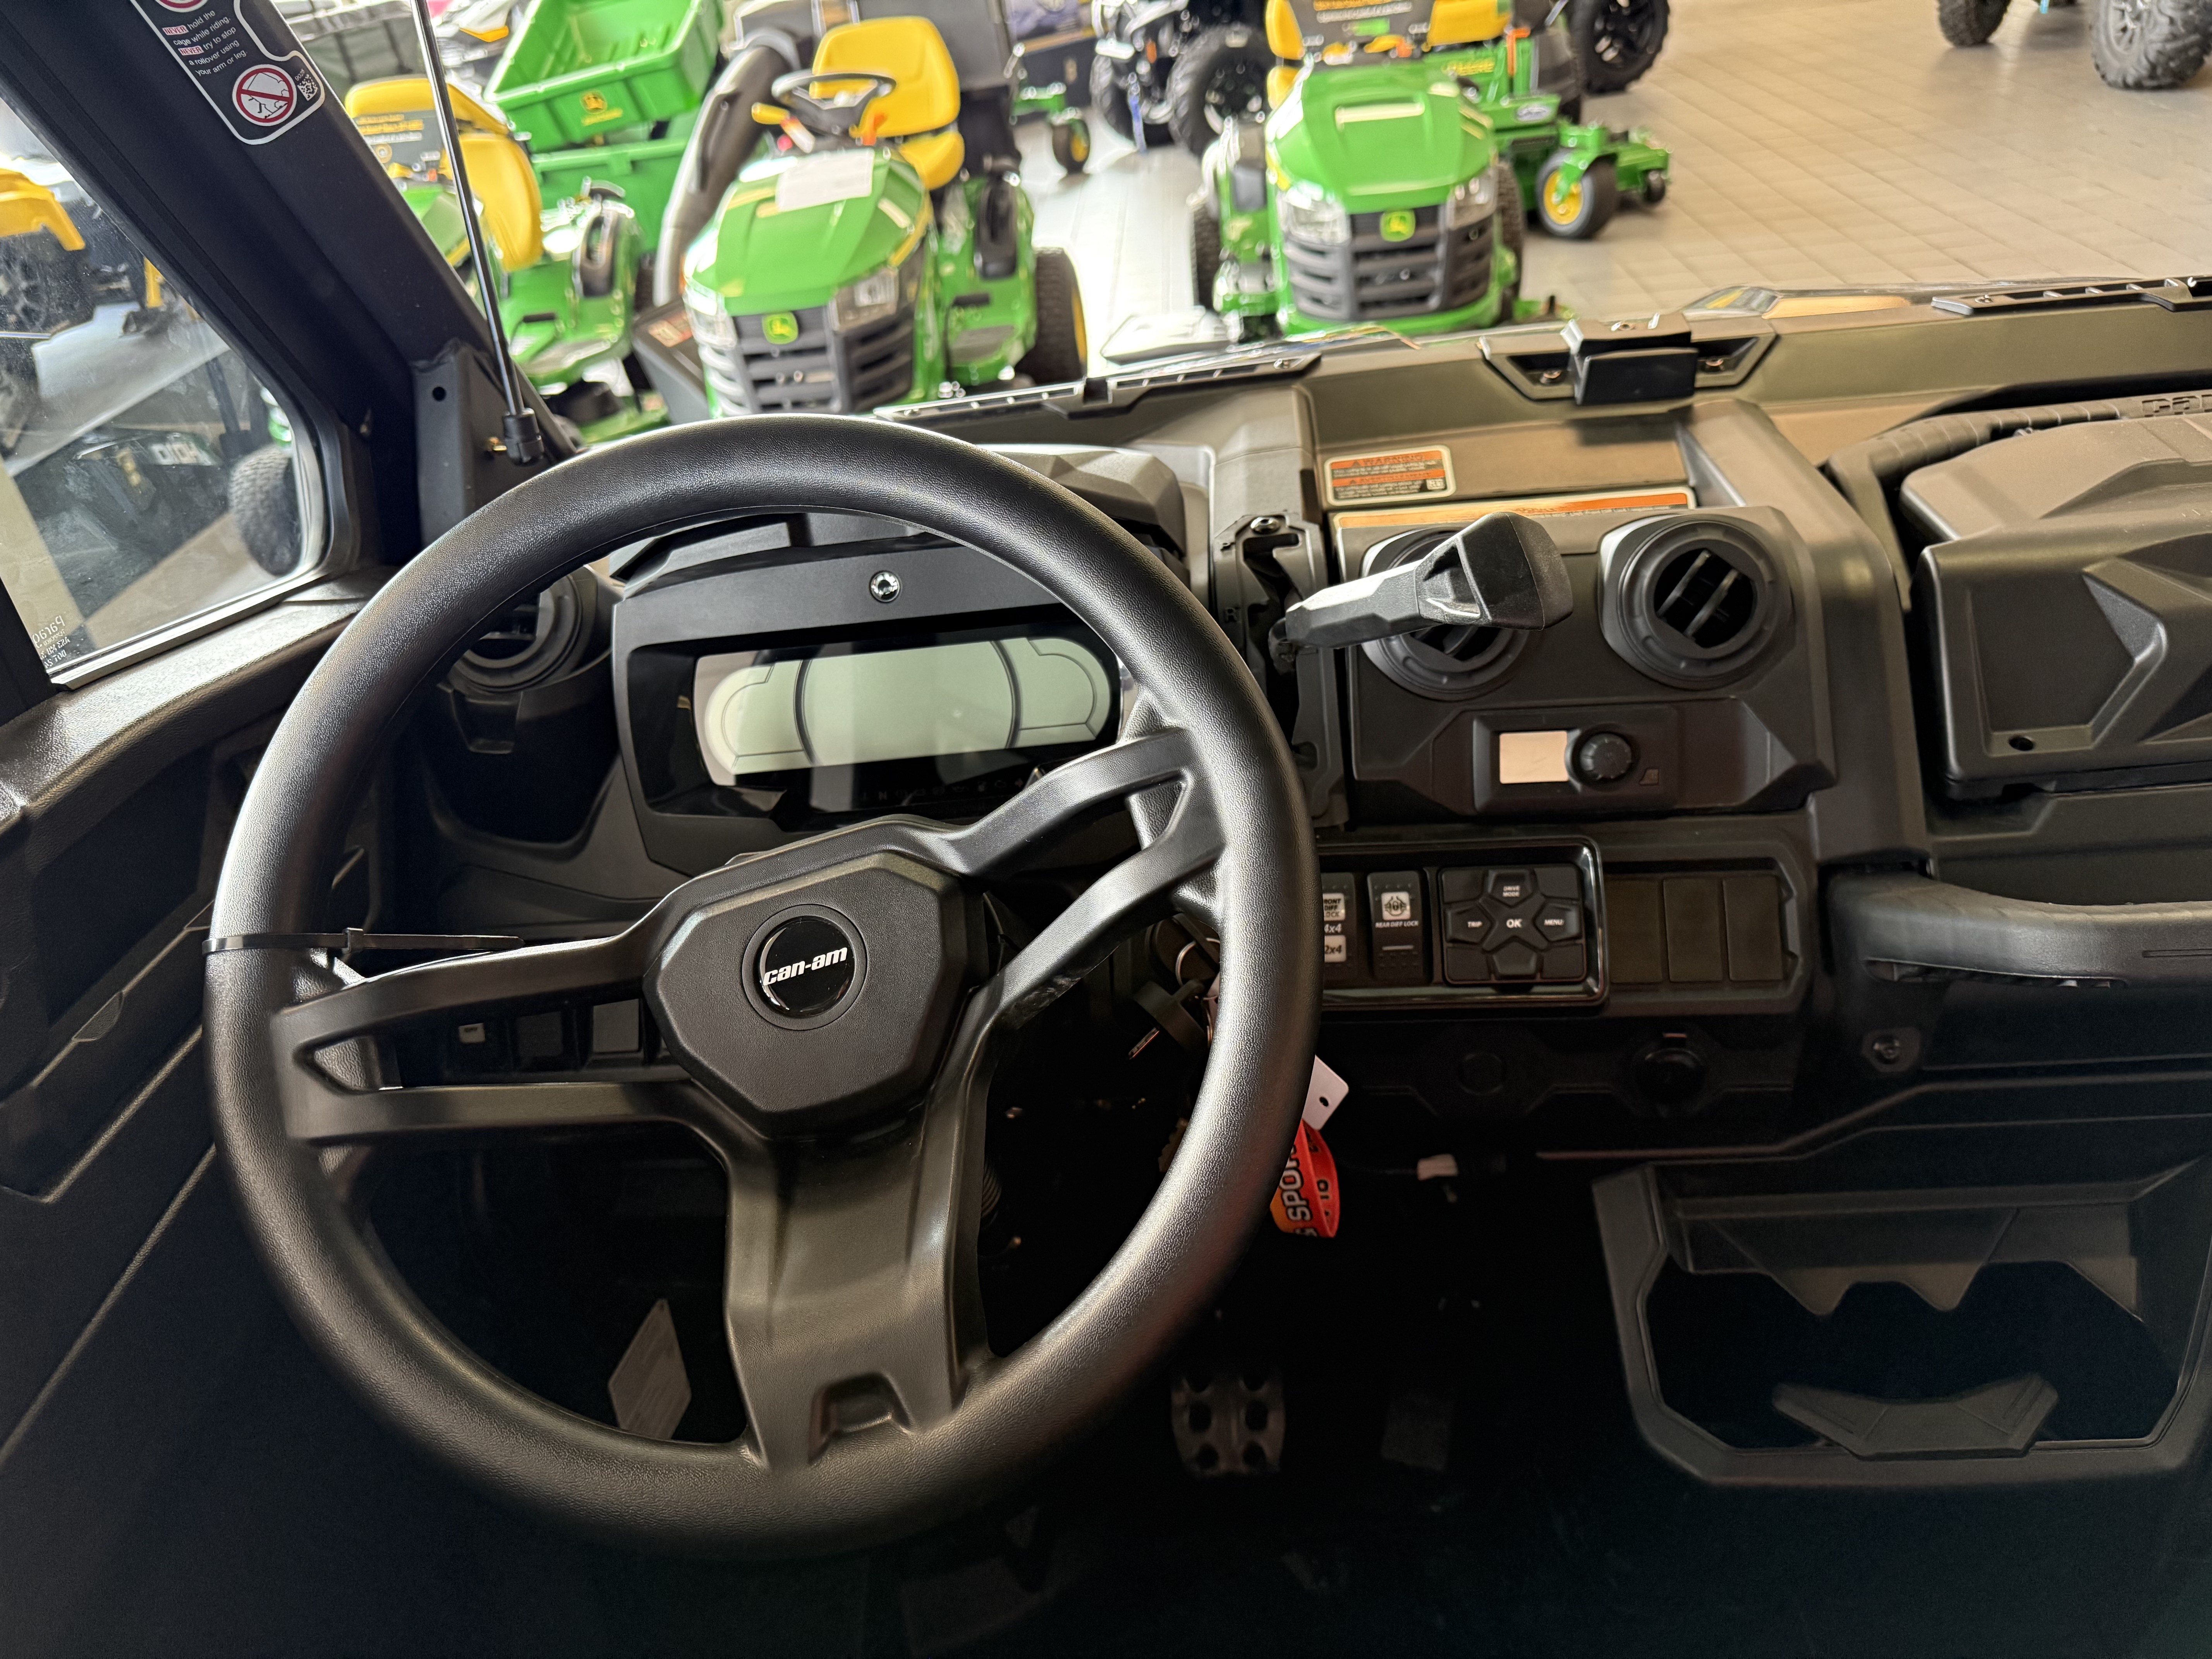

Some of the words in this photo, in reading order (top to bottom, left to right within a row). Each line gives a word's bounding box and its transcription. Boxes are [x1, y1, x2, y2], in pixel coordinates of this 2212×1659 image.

[164, 26, 187, 34] NEVER
[187, 16, 204, 30] hold
[203, 10, 215, 20] the
[191, 29, 210, 42] while
[210, 16, 231, 32] riding.
[180, 46, 202, 55] NEVER
[203, 41, 213, 50] try
[222, 27, 236, 39] stop
[196, 51, 220, 65] rollover
[220, 40, 240, 54] using
[213, 62, 227, 73] arm
[234, 50, 247, 59] leg.
[1324, 923, 1342, 933] 4x4
[1506, 919, 1523, 928] OK
[1324, 945, 1342, 954] 2x4
[763, 947, 848, 986] can-am
